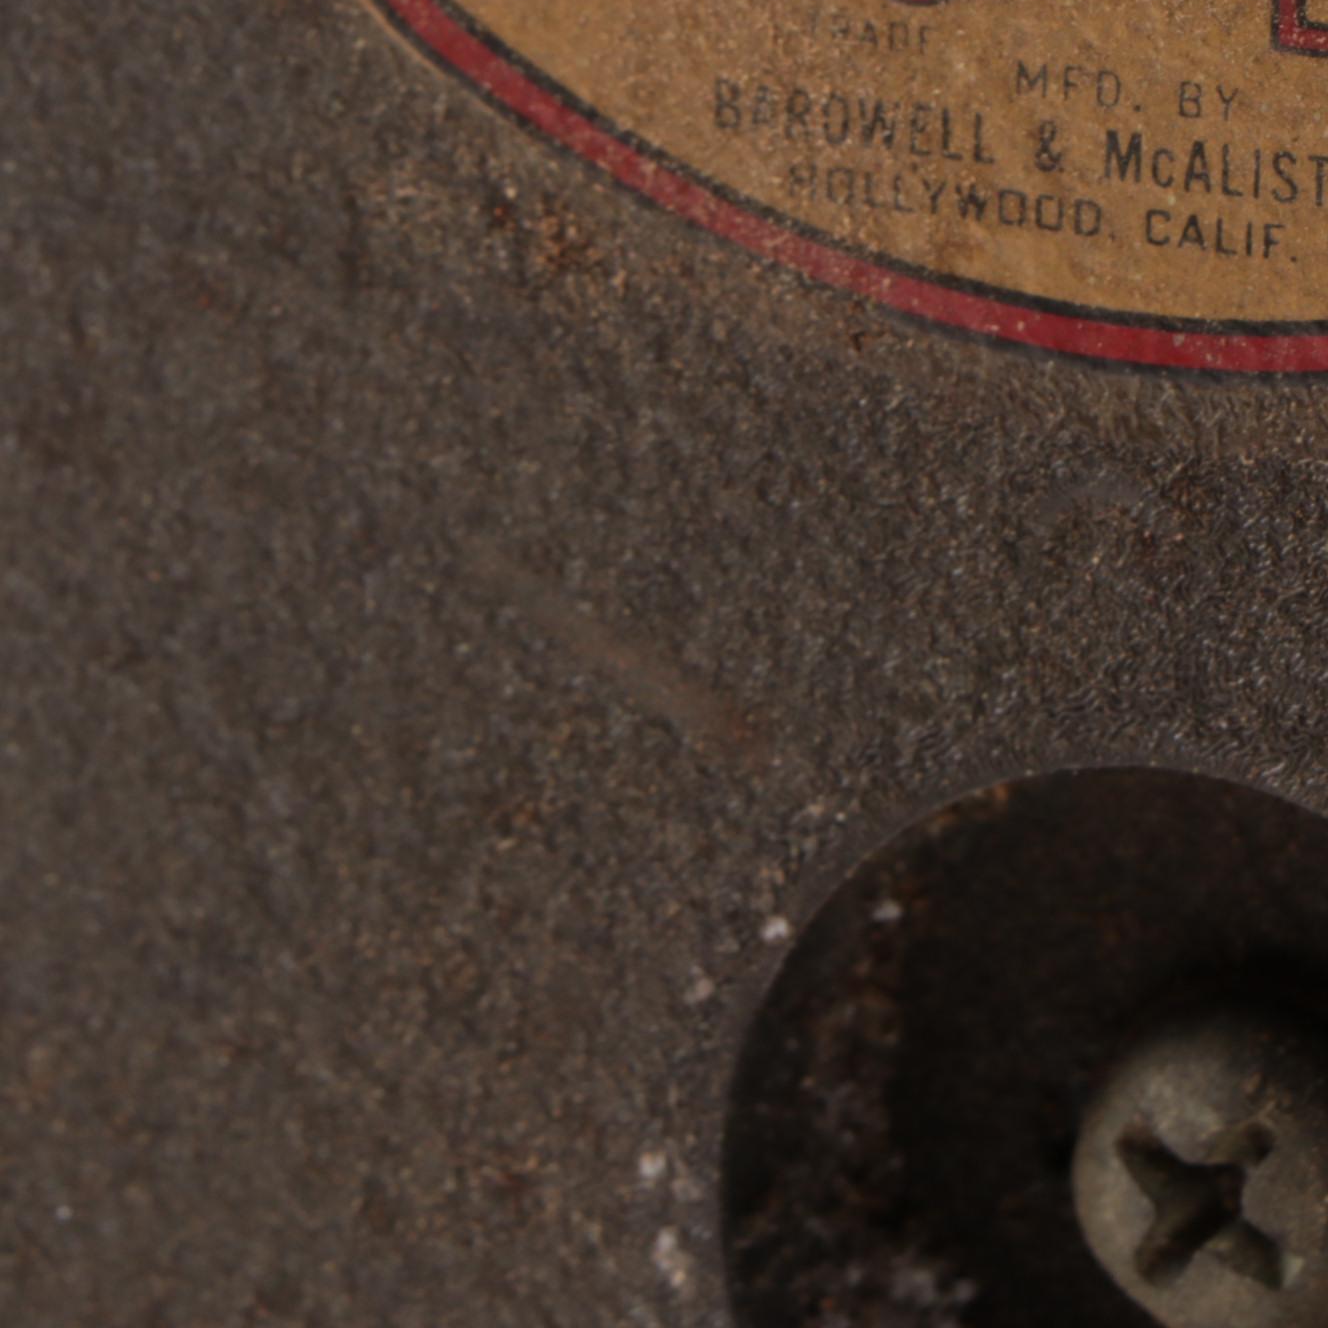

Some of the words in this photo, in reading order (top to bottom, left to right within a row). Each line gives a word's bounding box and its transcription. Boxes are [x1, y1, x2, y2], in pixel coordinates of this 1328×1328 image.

[1014, 59, 1142, 114] MFD.
[1178, 79, 1240, 122] BY
[1032, 119, 1064, 174] &
[1144, 207, 1299, 264] CALIF.
